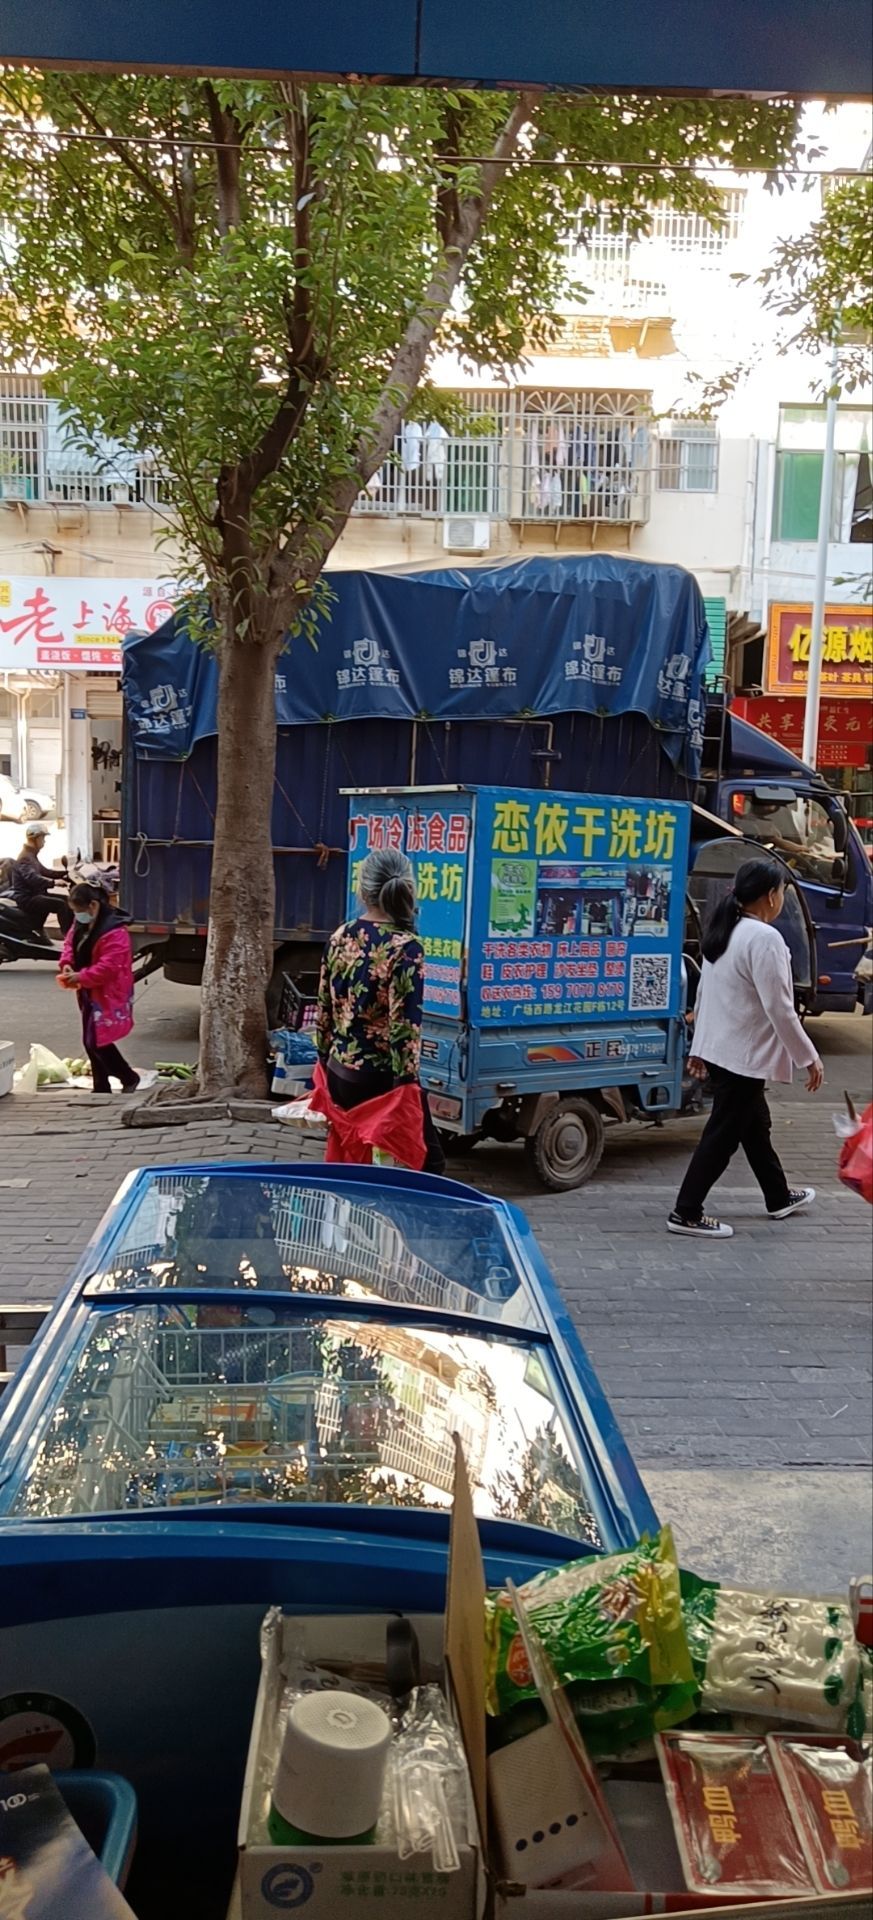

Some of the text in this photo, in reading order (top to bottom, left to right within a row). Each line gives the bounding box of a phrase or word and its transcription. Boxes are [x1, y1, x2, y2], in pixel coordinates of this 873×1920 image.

[335, 666, 401, 686] 锦达篷布
[448, 666, 518, 684] 锦达篷布
[491, 800, 677, 860] 恋依干洗坊
[541, 983, 563, 999] 159
[566, 983, 594, 998] 7070
